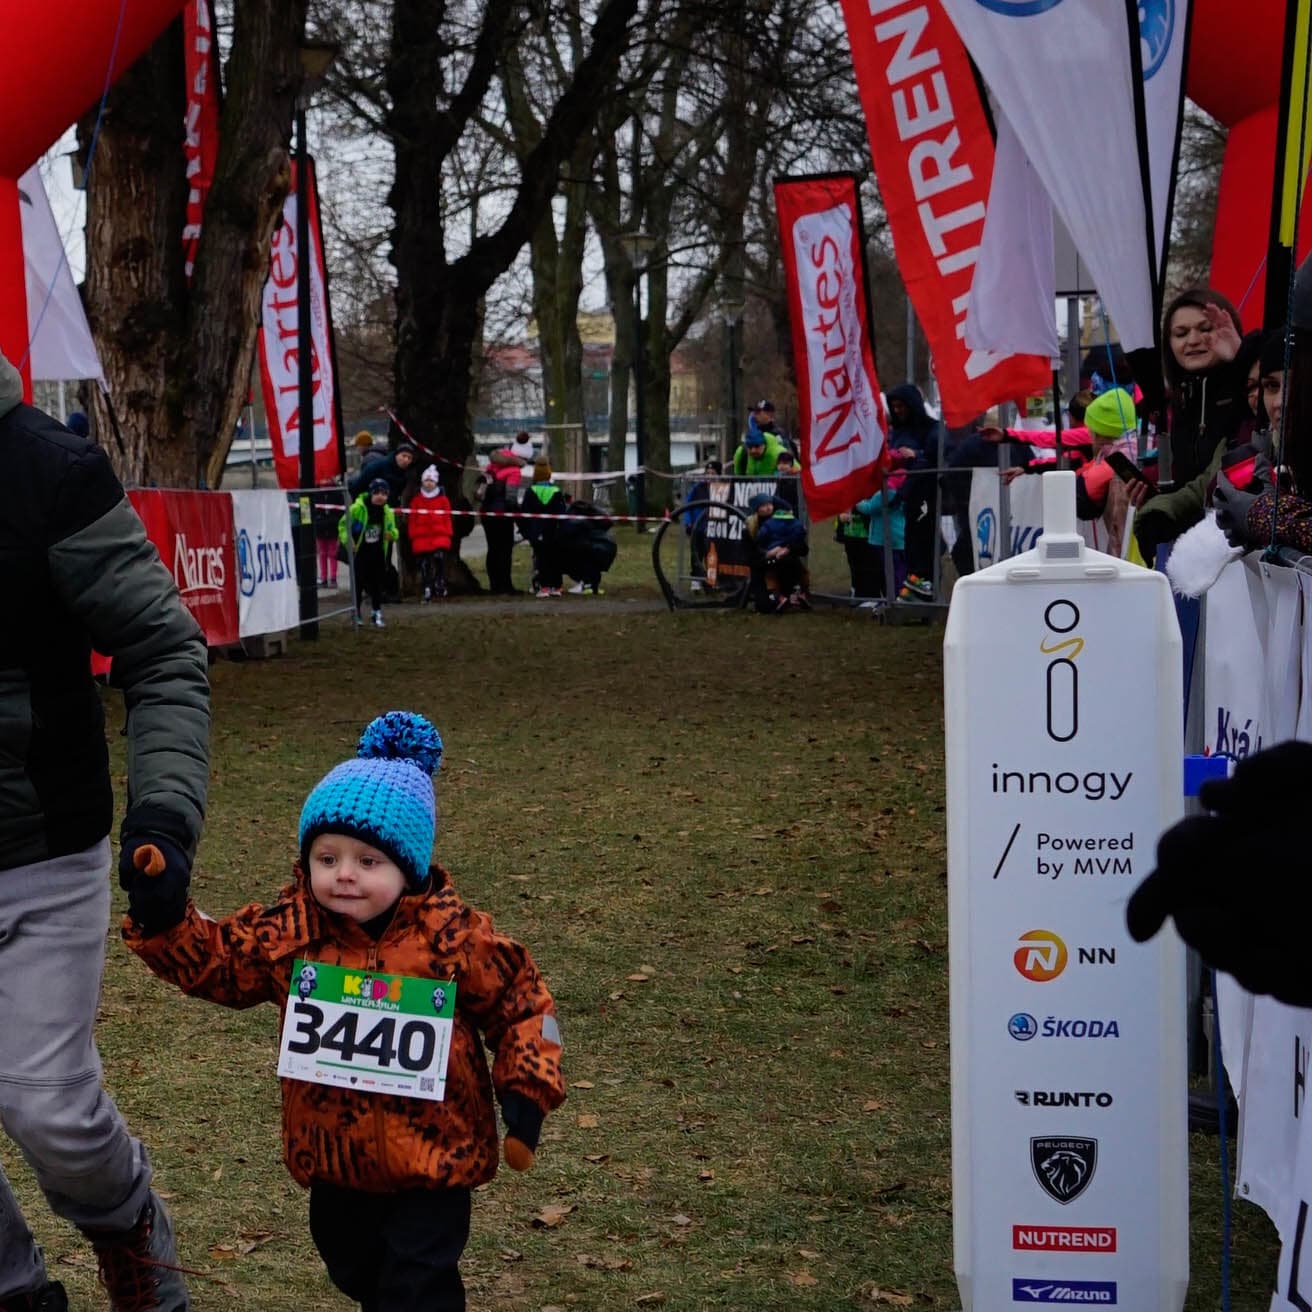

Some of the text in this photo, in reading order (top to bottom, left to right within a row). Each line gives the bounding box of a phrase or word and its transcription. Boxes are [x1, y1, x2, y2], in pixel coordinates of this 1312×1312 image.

[811, 234, 862, 462] Nartes
[991, 762, 1134, 801] innogy
[1036, 831, 1134, 851] Powered
[1036, 856, 1133, 881] by MVM
[1078, 947, 1116, 965] NN
[287, 1001, 437, 1073] 3440
[1041, 1015, 1120, 1039] ŠKODA
[1033, 1090, 1114, 1108] RUNTO
[1036, 1140, 1092, 1150] PEUGEOT
[1018, 1230, 1112, 1248] NUTREND
